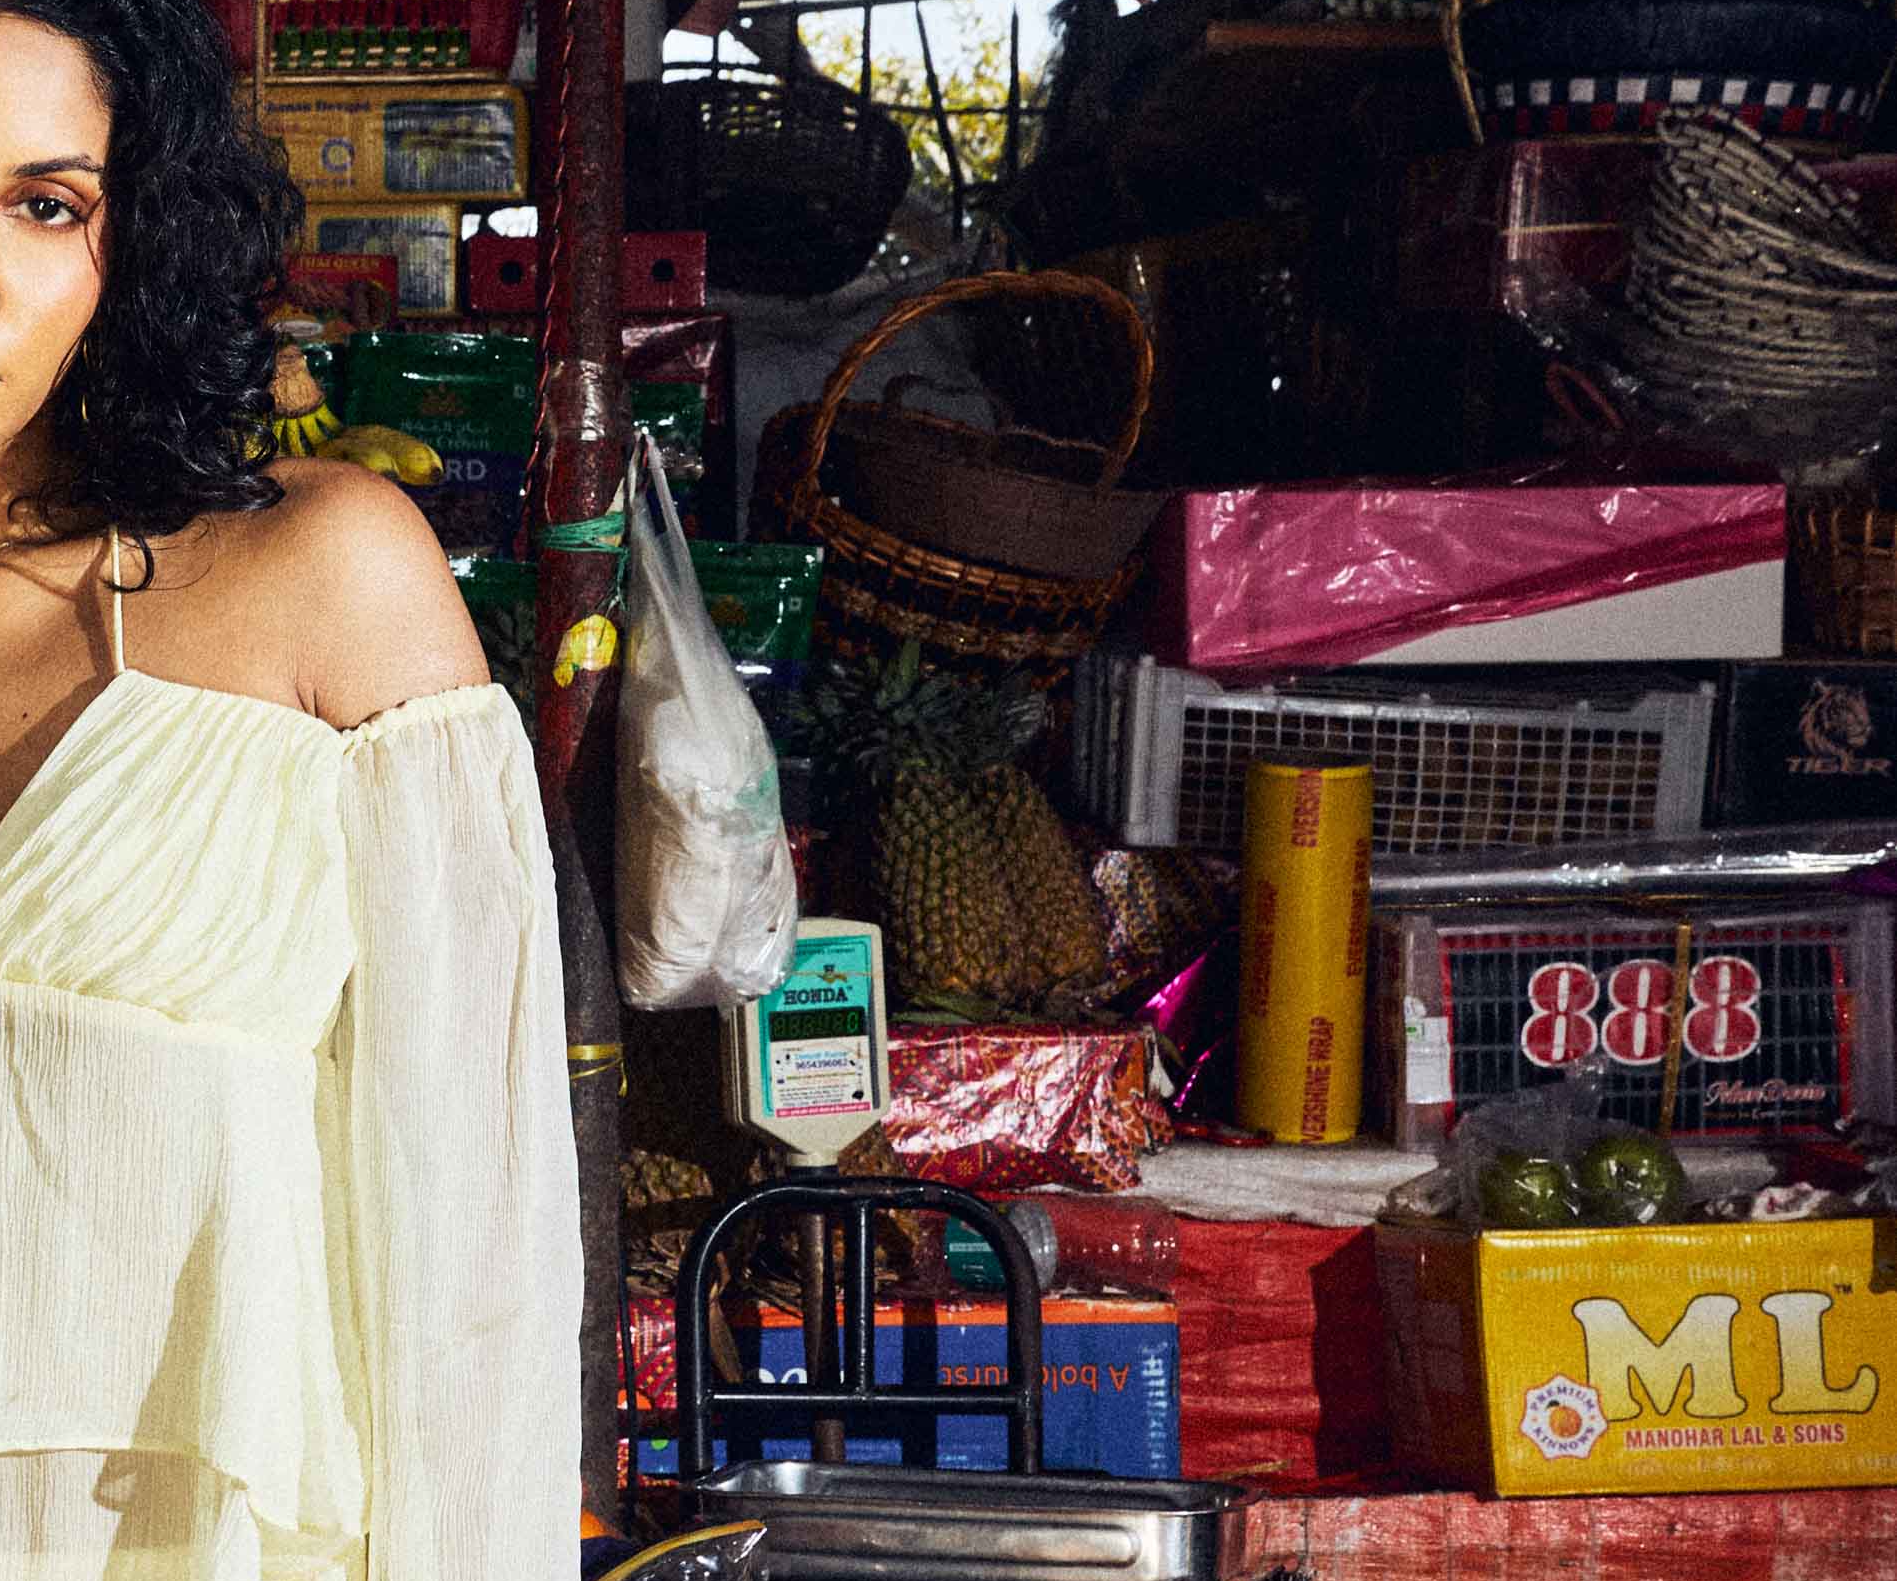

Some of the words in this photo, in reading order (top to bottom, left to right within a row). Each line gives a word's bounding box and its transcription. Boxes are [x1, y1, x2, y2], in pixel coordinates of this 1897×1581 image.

[1784, 754, 1893, 778] TIGER
[783, 987, 848, 1005] HONDA
[1520, 954, 1762, 1068] 888
[1301, 1063, 1330, 1142] VERSHINE
[1571, 1289, 1880, 1423] ML
[940, 1363, 1010, 1389] urst
[1040, 1363, 1098, 1393] bol
[1108, 1363, 1130, 1392] A
[1530, 1385, 1595, 1412] PREMIUM
[1624, 1426, 1725, 1450] MANOHAR
[1730, 1423, 1766, 1446] LAL
[1772, 1424, 1787, 1444] &
[1793, 1422, 1846, 1444] SONS
